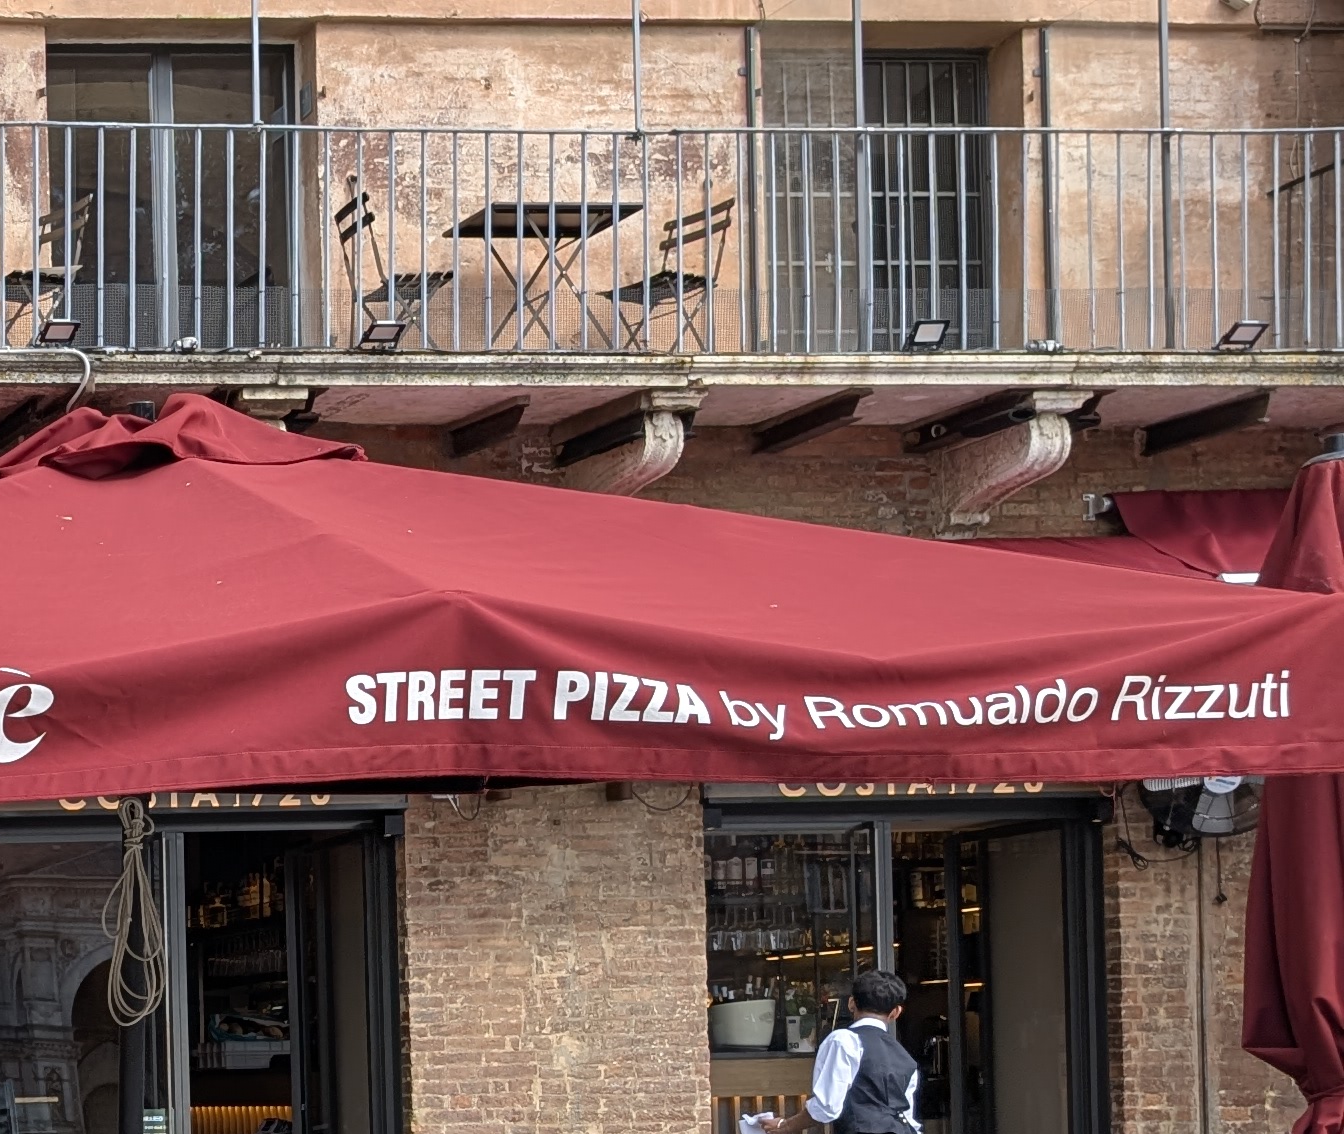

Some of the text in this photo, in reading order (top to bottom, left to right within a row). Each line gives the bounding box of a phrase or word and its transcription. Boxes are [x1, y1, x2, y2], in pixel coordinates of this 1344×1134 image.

[345, 669, 1291, 741] STREET PIZZA by Romualdo Rizzuti
